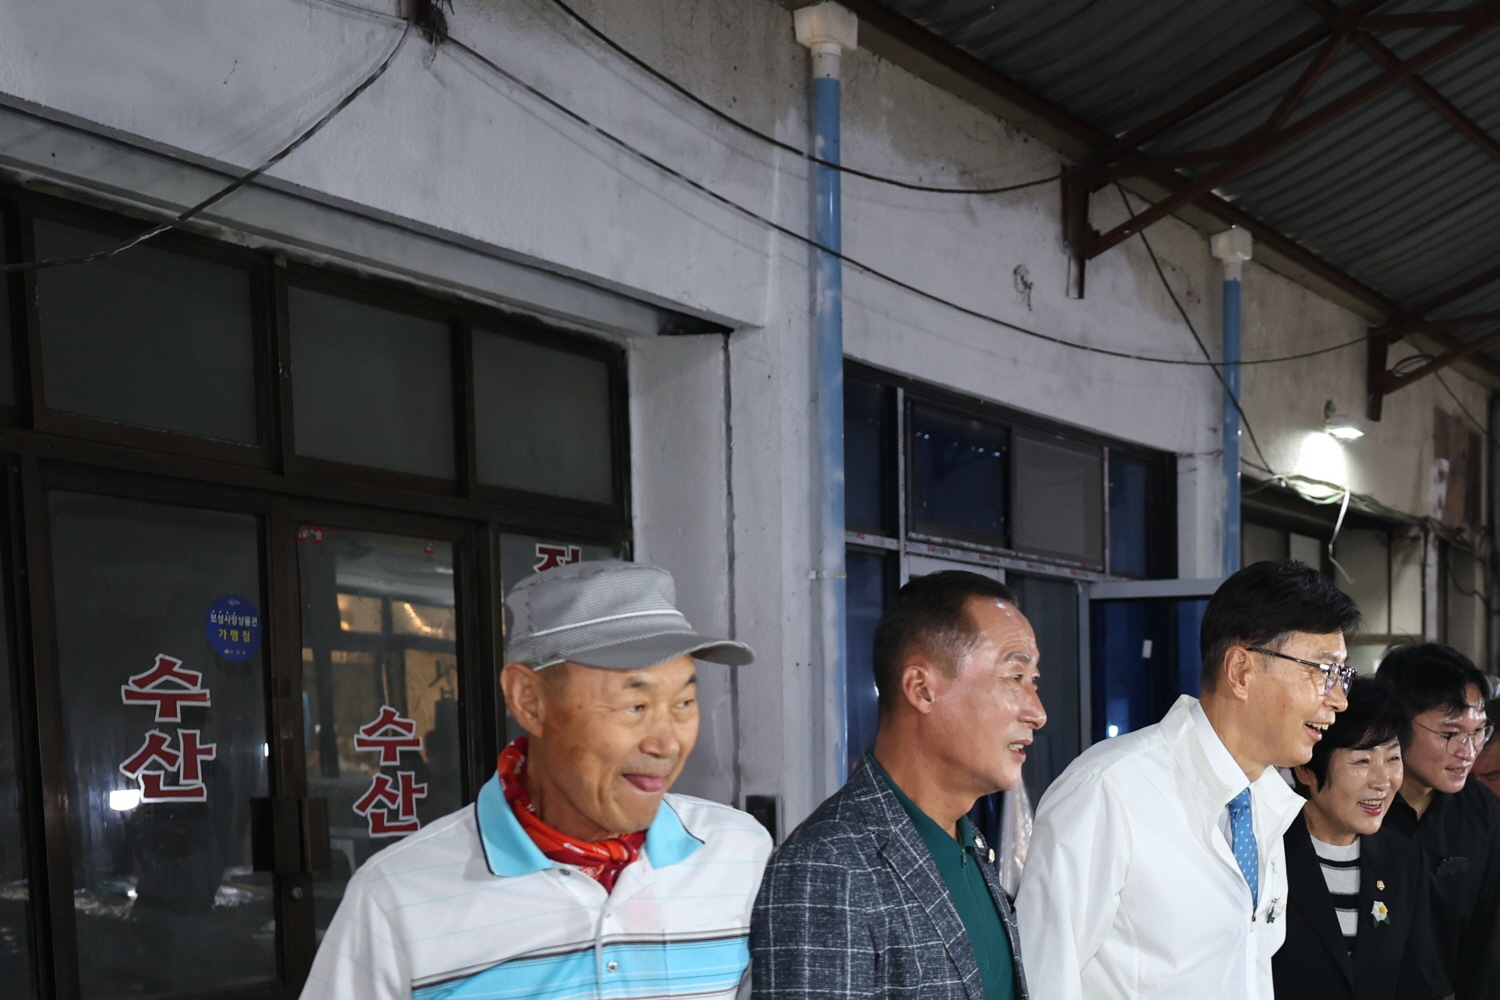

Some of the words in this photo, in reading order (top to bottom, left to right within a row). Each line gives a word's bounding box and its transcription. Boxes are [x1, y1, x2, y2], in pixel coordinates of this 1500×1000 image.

[210, 612, 258, 628] 보성사랑상품권
[119, 653, 217, 804] 수산
[353, 705, 427, 838] 수산
